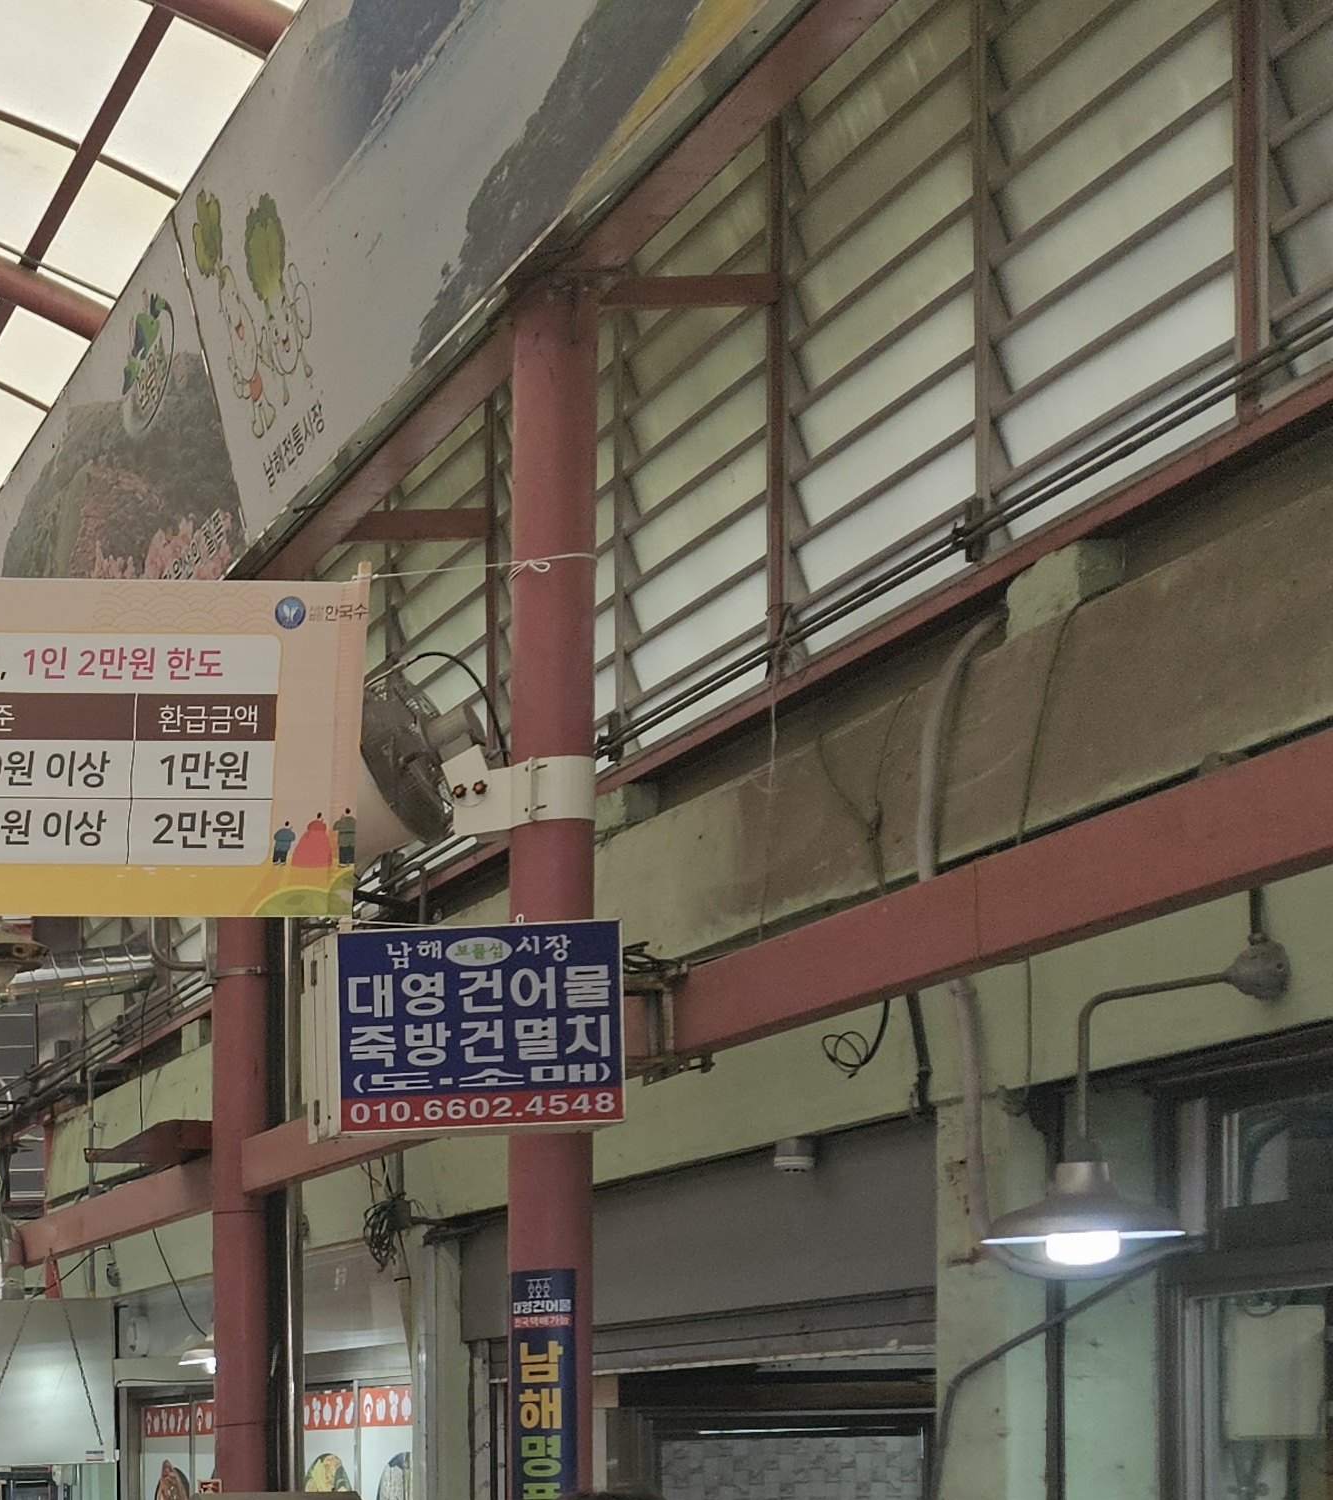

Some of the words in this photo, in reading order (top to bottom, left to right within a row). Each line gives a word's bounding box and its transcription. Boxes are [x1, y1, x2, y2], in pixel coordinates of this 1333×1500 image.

[22, 647, 69, 680] 1인
[77, 648, 157, 682] 2만원
[166, 647, 223, 680] 한도
[158, 704, 259, 735] 환급금액
[46, 750, 111, 789] 이상
[159, 753, 250, 791] 1만원
[42, 809, 107, 848] 이상
[152, 809, 247, 850] 2만원
[386, 940, 443, 969] 남해
[516, 934, 572, 962] 시장
[347, 964, 612, 1018] 대영건어물
[349, 1014, 612, 1067] 죽방건멸치
[349, 1092, 616, 1125] 010.6602.4548
